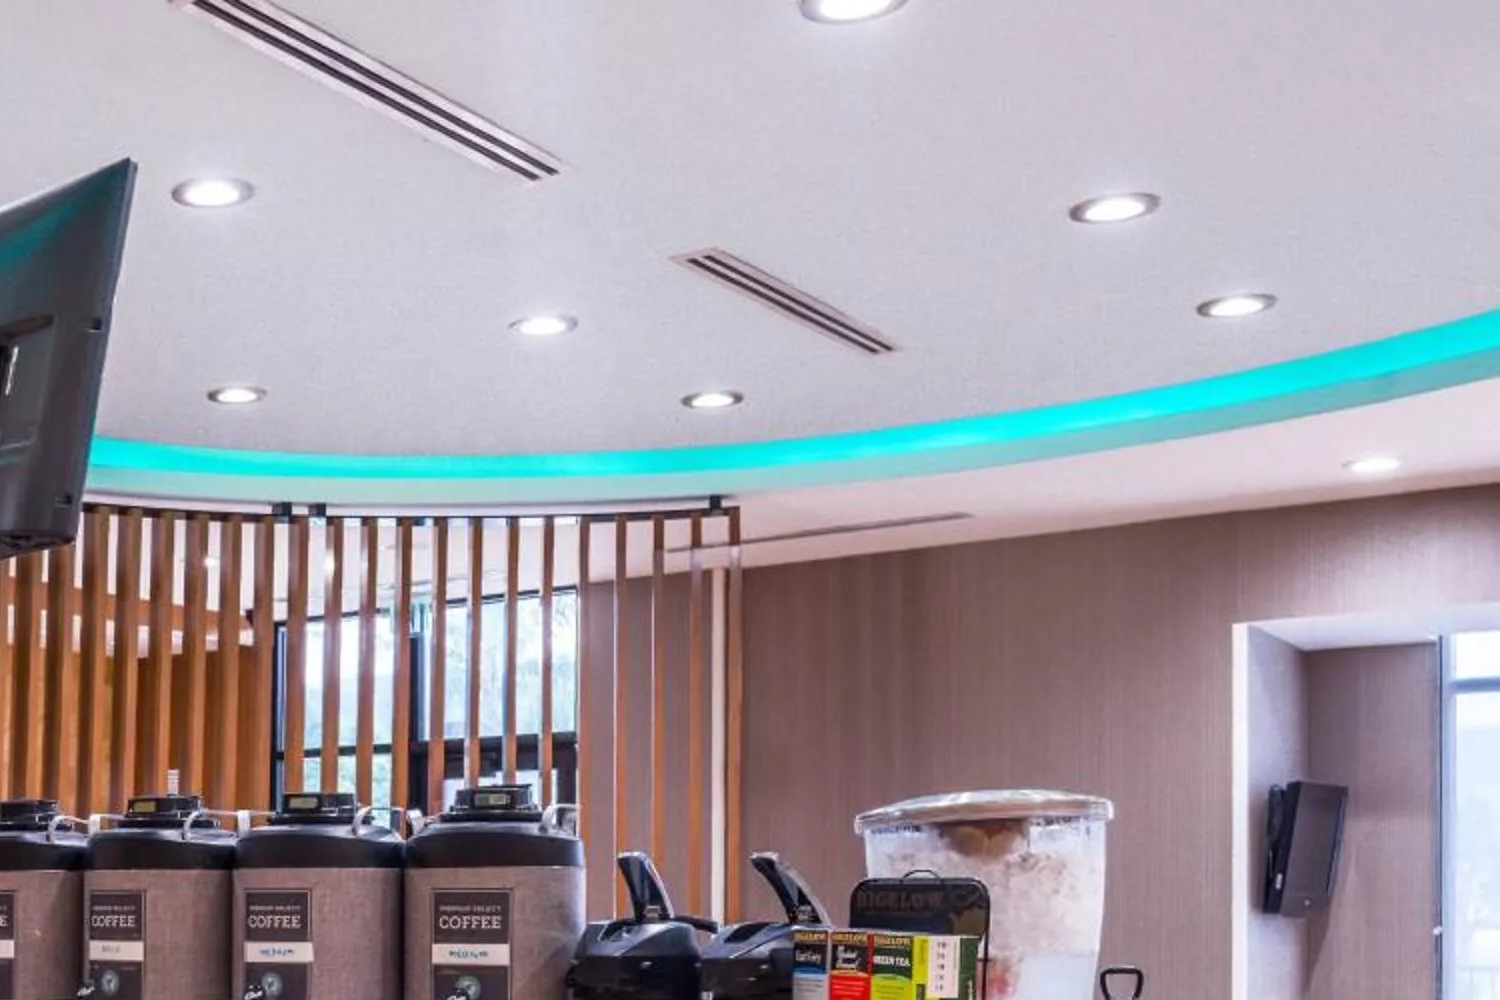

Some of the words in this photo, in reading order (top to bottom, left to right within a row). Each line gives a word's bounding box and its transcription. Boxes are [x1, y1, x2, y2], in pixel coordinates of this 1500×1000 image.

[92, 915, 137, 927] COFFEE
[248, 915, 301, 929] COFFEE
[439, 915, 502, 929] COFFEE
